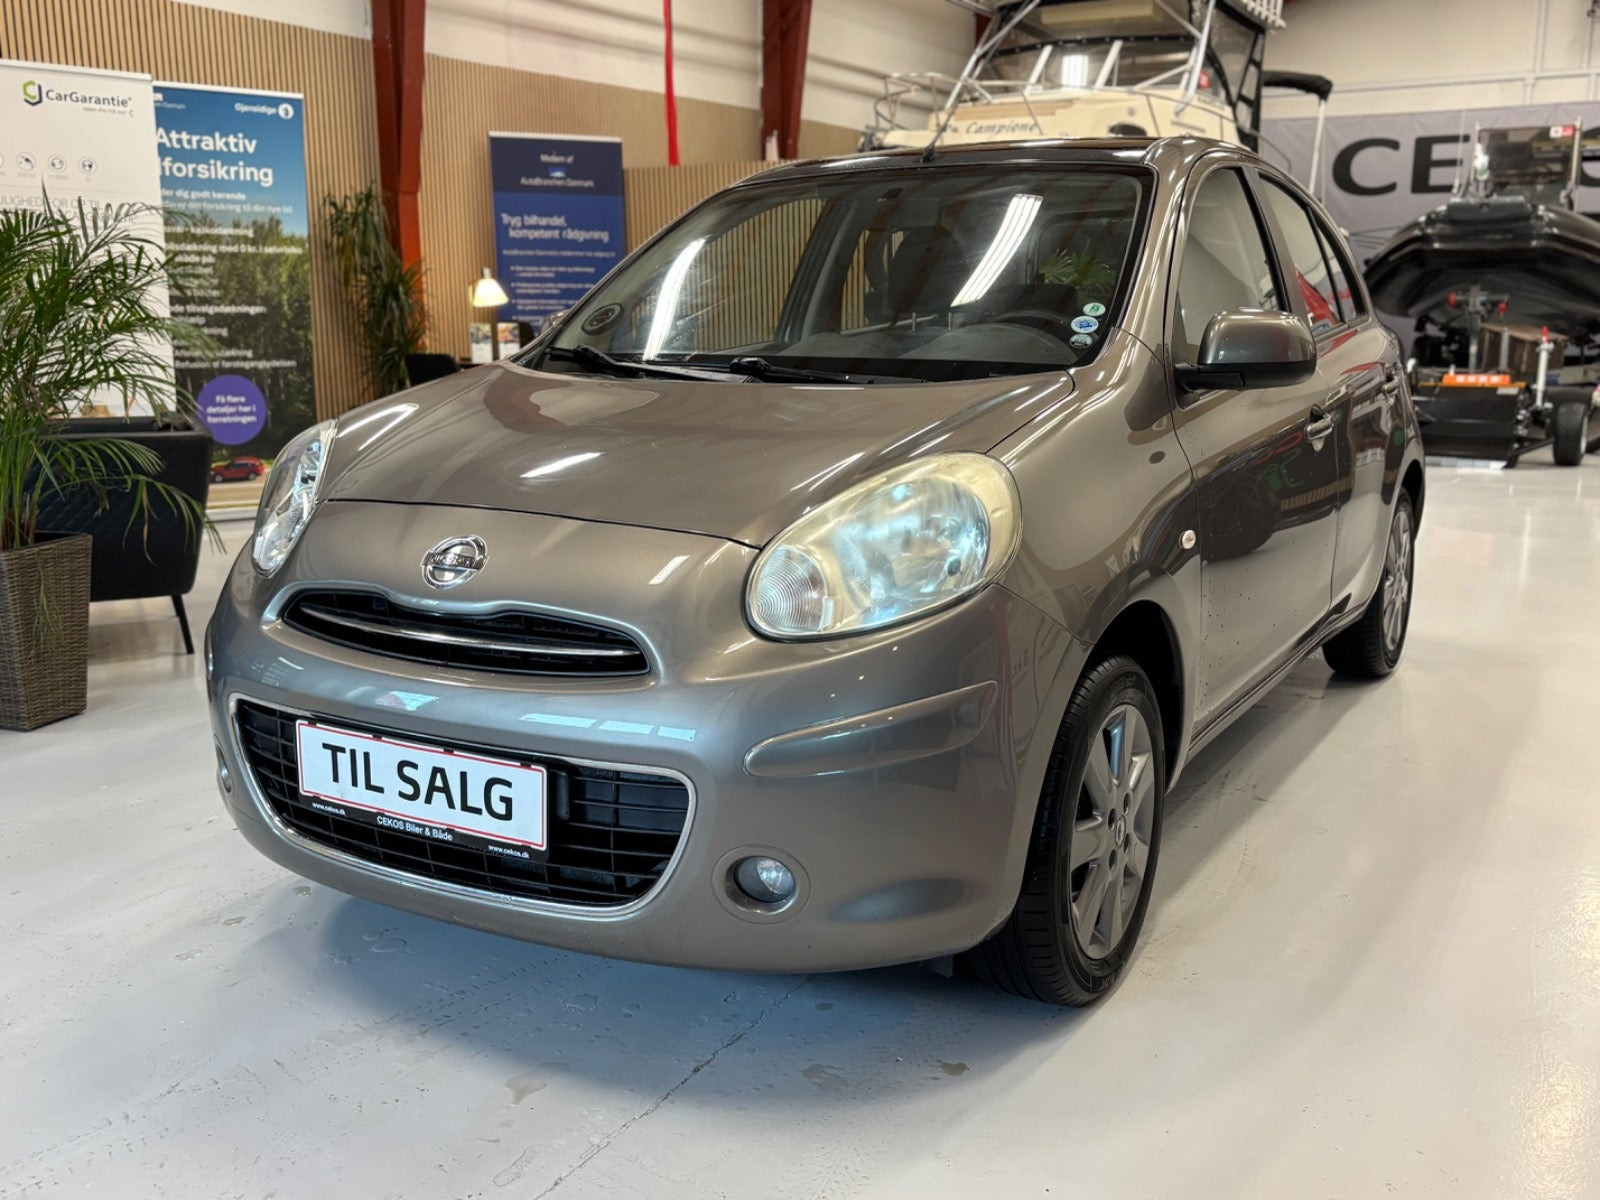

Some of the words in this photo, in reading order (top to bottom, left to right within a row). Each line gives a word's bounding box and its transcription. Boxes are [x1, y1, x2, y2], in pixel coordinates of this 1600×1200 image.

[45, 88, 129, 107] CarGarantie
[156, 127, 257, 153] Attraktiv
[322, 742, 385, 794] TIL
[396, 759, 513, 821] SALG
[376, 815, 405, 830] CEKOS
[405, 822, 423, 835] Biler
[424, 827, 431, 836] &
[432, 828, 453, 841] Både
[488, 844, 530, 859] www.cekos.dk
